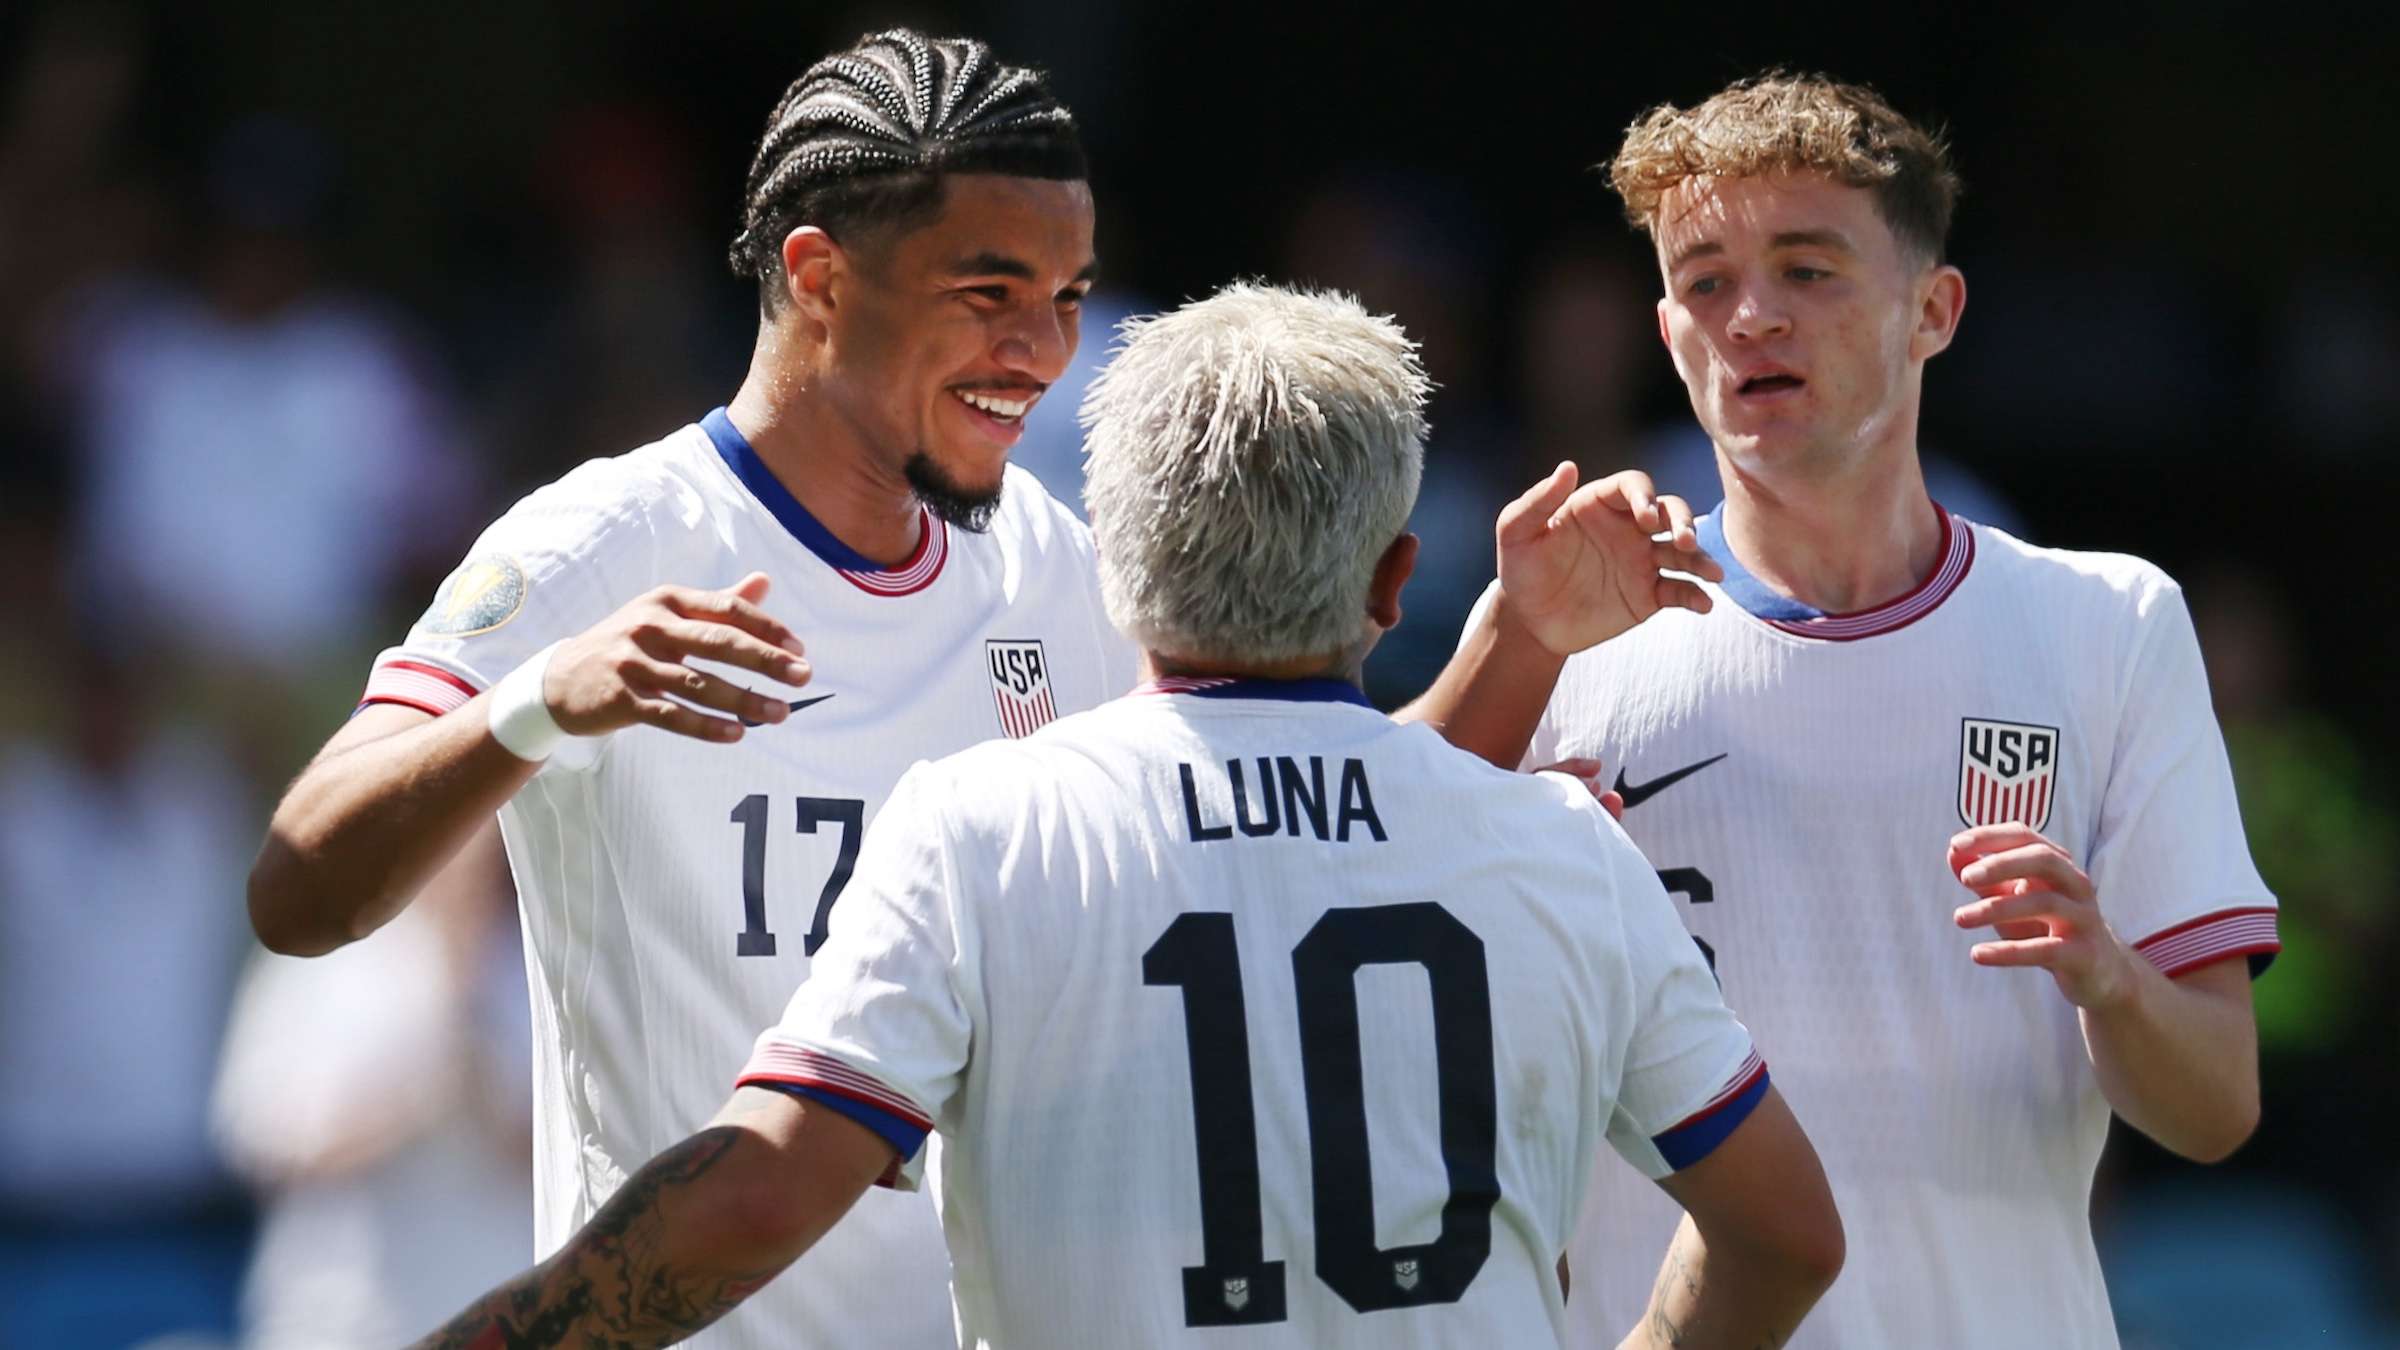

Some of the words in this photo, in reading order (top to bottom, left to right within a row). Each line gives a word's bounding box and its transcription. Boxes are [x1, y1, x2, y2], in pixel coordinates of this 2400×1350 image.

[991, 648, 1042, 695] USA
[1969, 726, 2051, 778] USA
[1179, 756, 1388, 842] LUNA
[730, 794, 865, 957] 17
[1142, 901, 1501, 1328] 10
